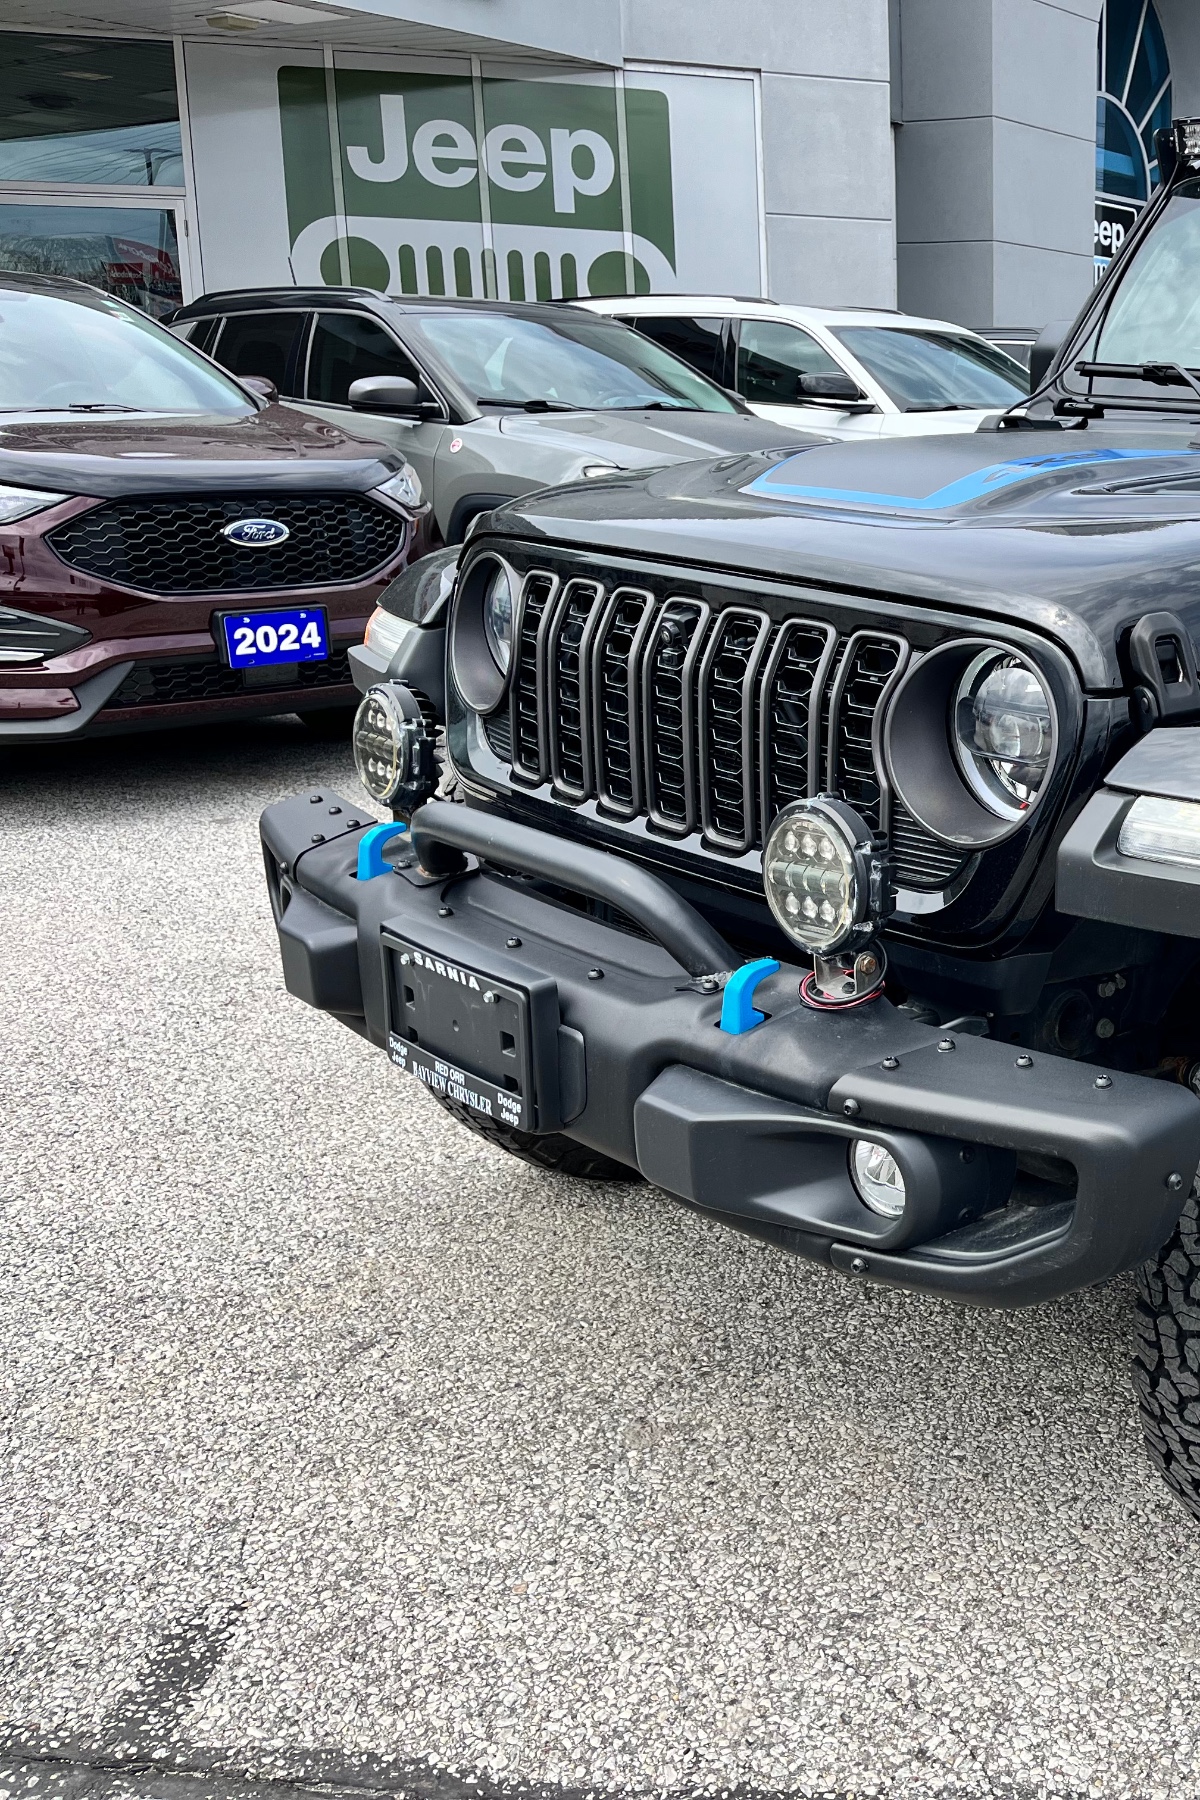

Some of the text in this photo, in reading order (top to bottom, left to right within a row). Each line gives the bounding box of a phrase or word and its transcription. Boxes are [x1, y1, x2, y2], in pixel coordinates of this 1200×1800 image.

[346, 94, 615, 214] Jeep
[241, 524, 276, 541] Ford
[233, 621, 322, 656] 2024
[412, 952, 481, 991] SARNIA
[389, 1037, 408, 1056] Dodge
[391, 1051, 406, 1068] Jeep
[434, 1061, 466, 1086] RED ORR
[412, 1061, 493, 1117] BAYVIEW CHRYSLER
[497, 1093, 522, 1114] Dodge
[500, 1107, 519, 1127] Jeep
